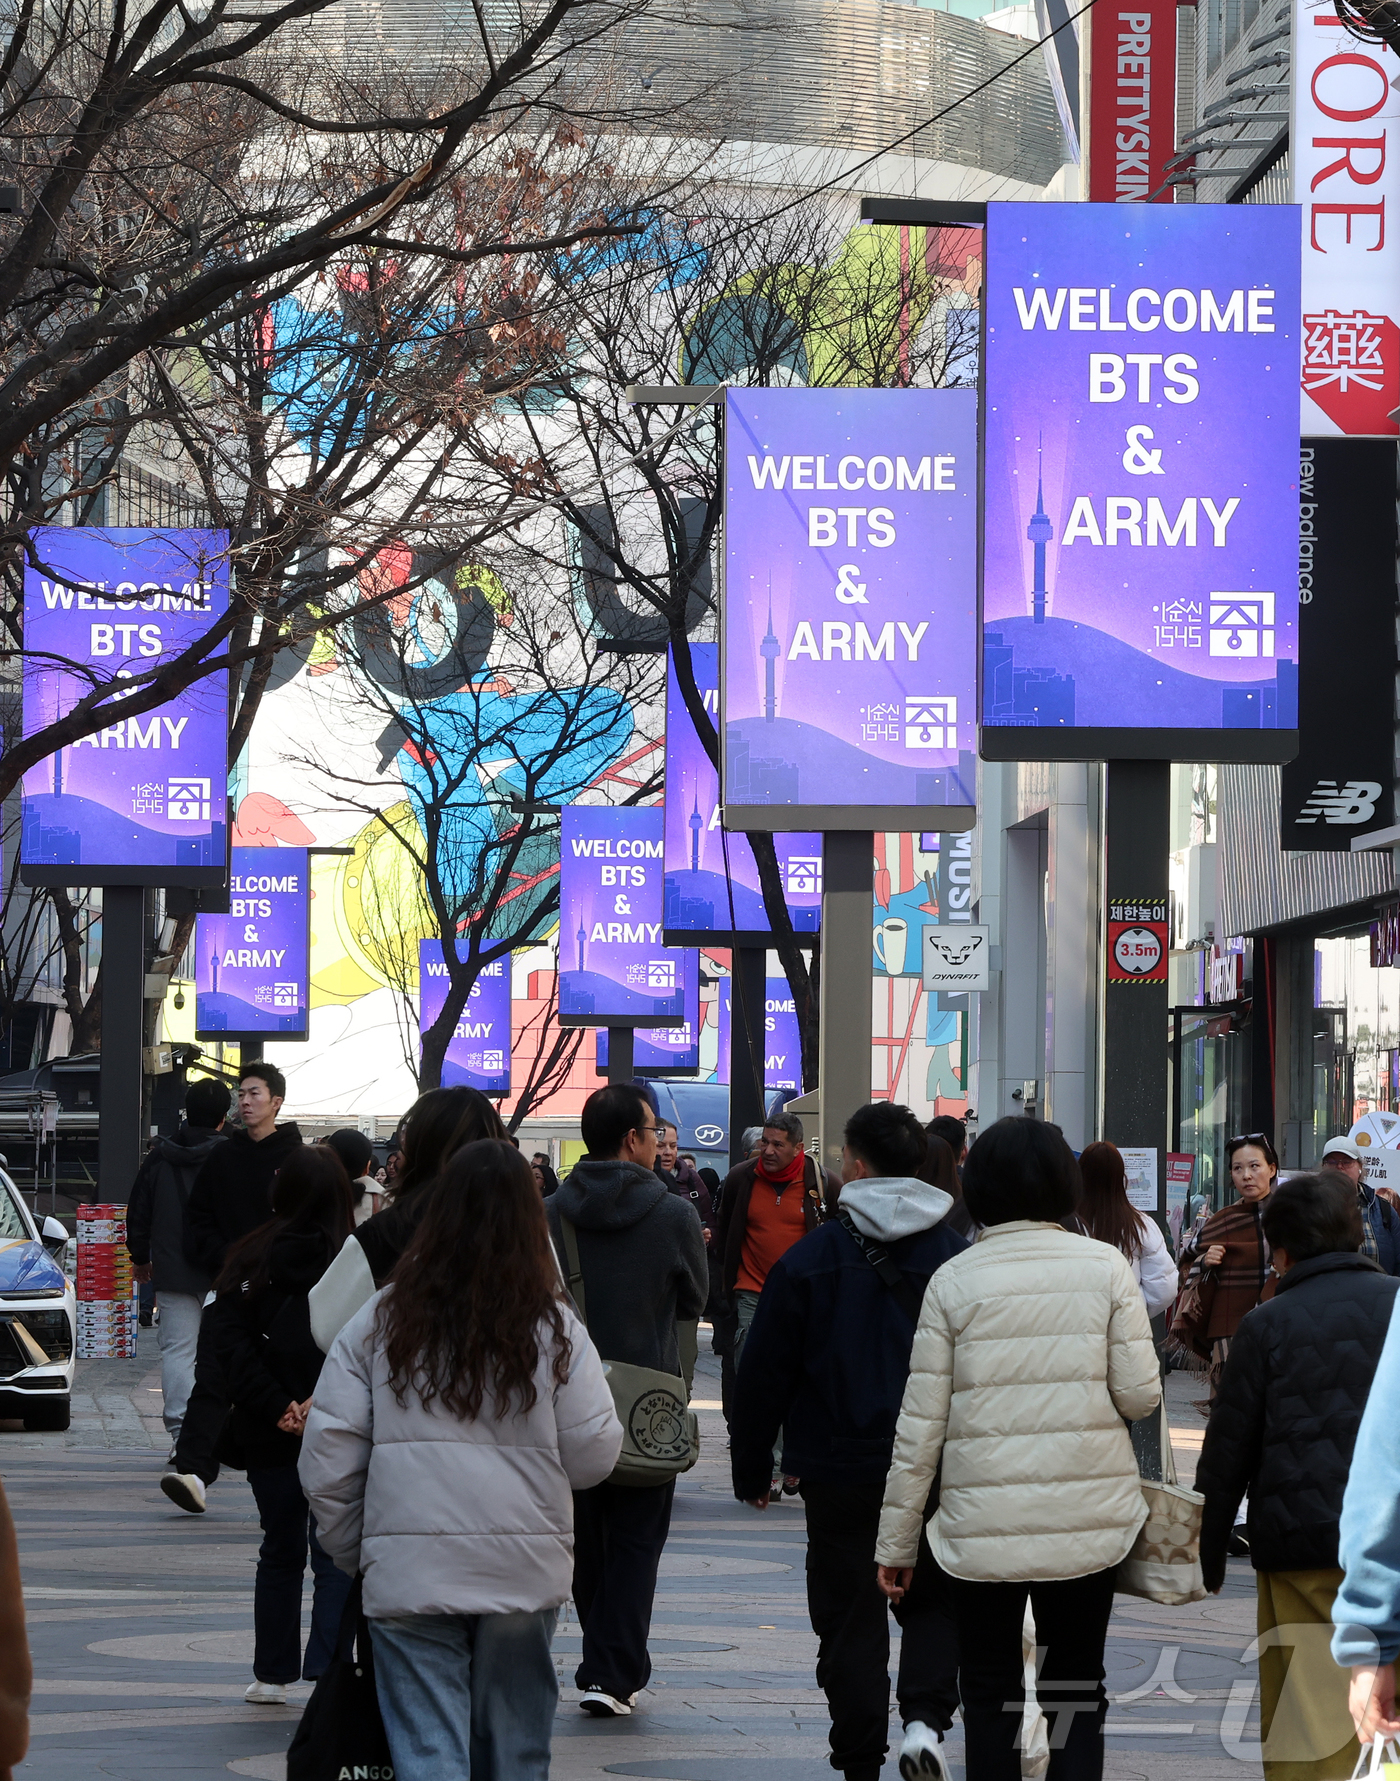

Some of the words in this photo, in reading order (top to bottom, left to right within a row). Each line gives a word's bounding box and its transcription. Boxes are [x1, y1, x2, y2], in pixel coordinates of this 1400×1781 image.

[1115, 12, 1152, 201] PRETTYSKIN
[1012, 287, 1276, 333] WELCOME
[1304, 312, 1384, 392] 藥
[1089, 353, 1200, 404] BTS
[1122, 423, 1166, 475] &
[747, 455, 956, 491] WELCOME
[1300, 448, 1315, 497] new
[808, 507, 896, 548] BTS
[1061, 496, 1242, 547] ARMY
[1299, 503, 1318, 605] balance
[835, 564, 870, 605] &
[40, 581, 212, 612] WELCOME
[1152, 600, 1202, 623] 이순신
[90, 623, 163, 657] BTS
[787, 621, 930, 662] ARMY
[1153, 625, 1202, 648] 1545
[860, 723, 899, 741] 1545
[131, 799, 163, 813] 1545
[571, 839, 664, 858] WELCOM
[601, 865, 646, 887] BTS
[948, 831, 971, 925] MUSI
[232, 899, 272, 918] BTS
[613, 893, 632, 915] &
[1110, 905, 1166, 921] 제한높이
[243, 923, 260, 943] &
[589, 922, 662, 944] ARMY
[222, 949, 286, 968] ARMY
[1120, 943, 1158, 957] 3.5m
[426, 963, 503, 977] WEME
[626, 973, 646, 984] 1545
[931, 973, 981, 981] DYNAFIT
[452, 1023, 493, 1038] RMY
